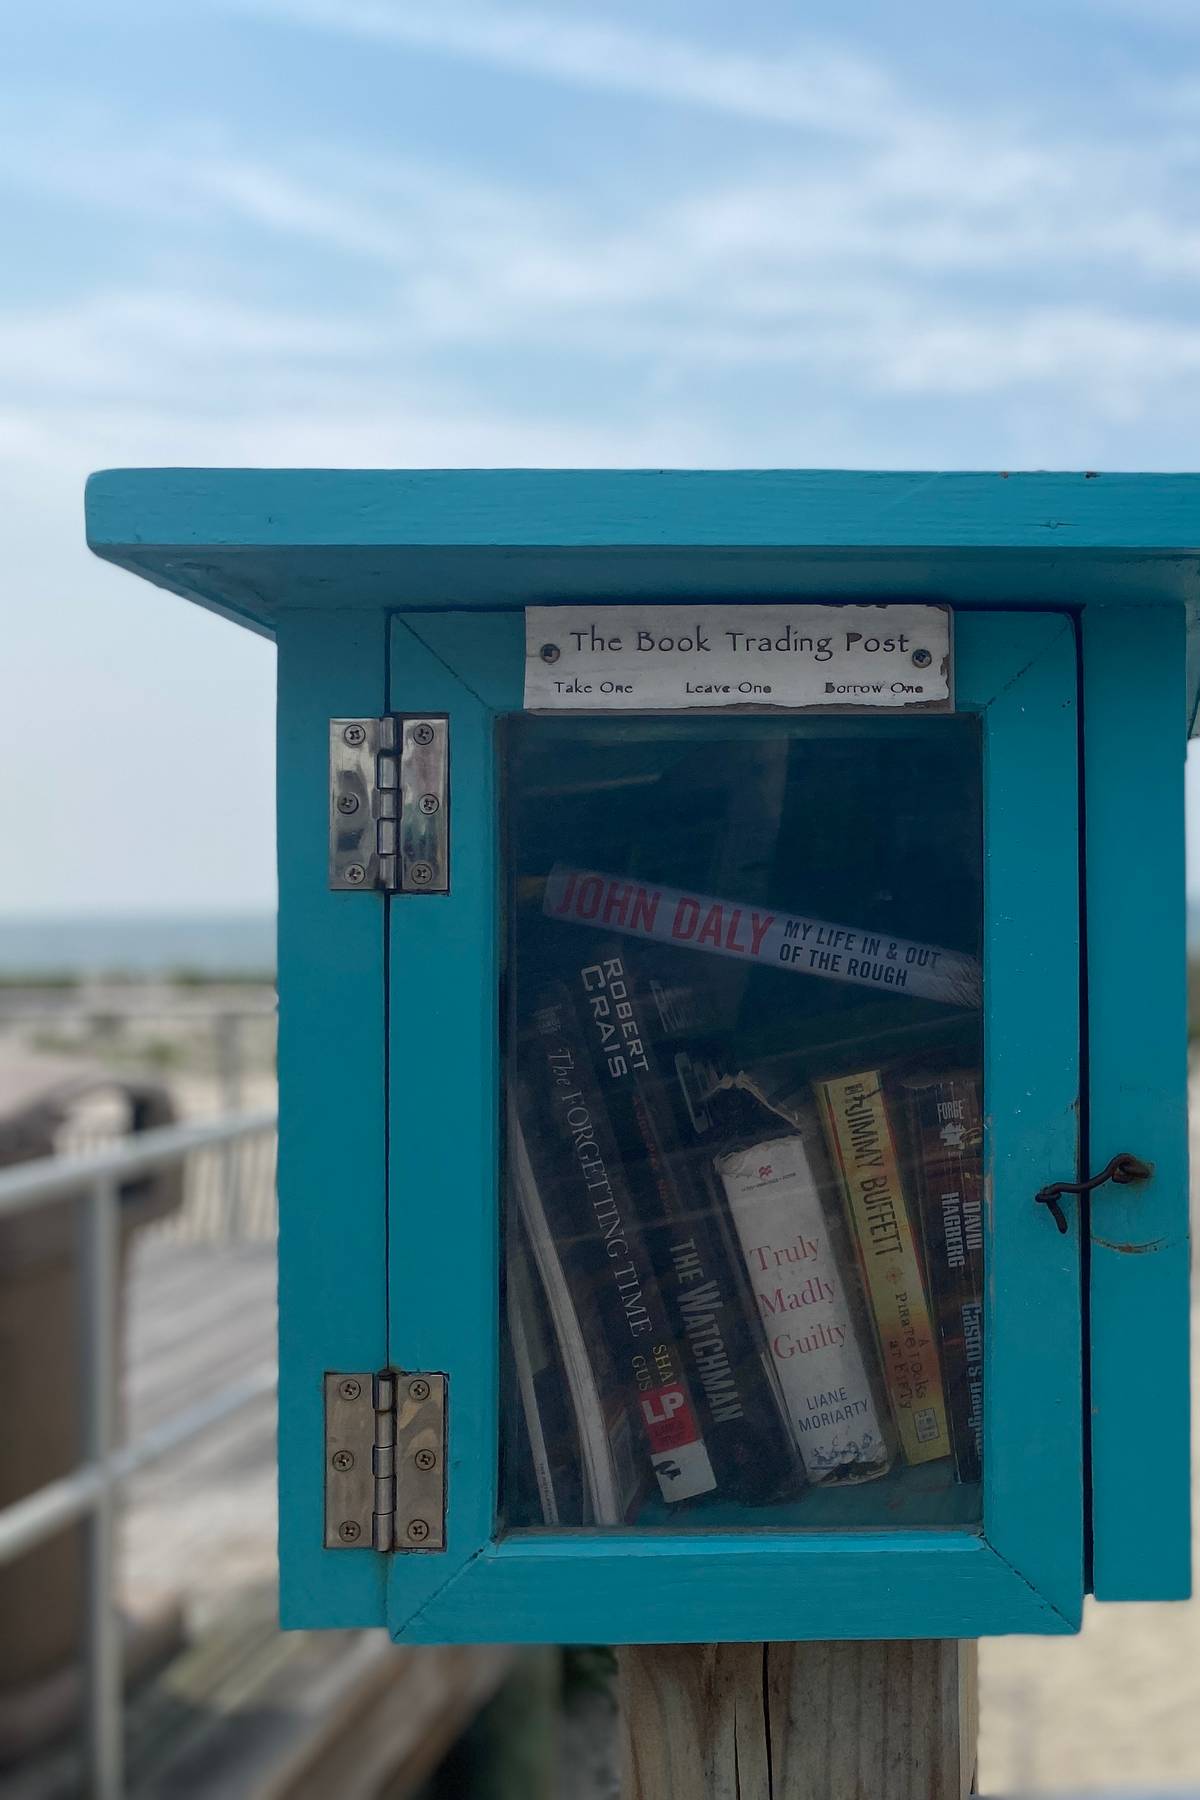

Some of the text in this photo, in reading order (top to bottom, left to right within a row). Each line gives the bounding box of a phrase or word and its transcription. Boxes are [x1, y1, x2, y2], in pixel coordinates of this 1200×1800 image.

[570, 625, 909, 661] The Book Trading Post
[554, 682, 633, 694] Take One
[686, 682, 772, 694] Leave One
[825, 681, 923, 694] Borrow One
[556, 872, 775, 955] JOHN DALY
[784, 920, 941, 968] MY LIFE IN & OUT
[779, 944, 908, 987] OF THE ROUGH
[581, 965, 628, 1079] CRAIS
[604, 957, 649, 1072] ROBERT
[937, 1100, 966, 1121] FORGE
[845, 1106, 885, 1169] JIMMY
[548, 1048, 654, 1337] The FORGETTING TIME
[860, 1176, 904, 1256] BUFFETT
[941, 1192, 966, 1269] HAGBERG
[961, 1201, 982, 1250] DAVID
[749, 1236, 820, 1272] Truly
[758, 1276, 837, 1318] Madly
[669, 1239, 743, 1423] THE WATCHMAN
[773, 1322, 848, 1360] Guilty
[641, 1391, 684, 1425] LP
[799, 1400, 869, 1432] MORIARTY
[806, 1387, 848, 1411] LIANE
